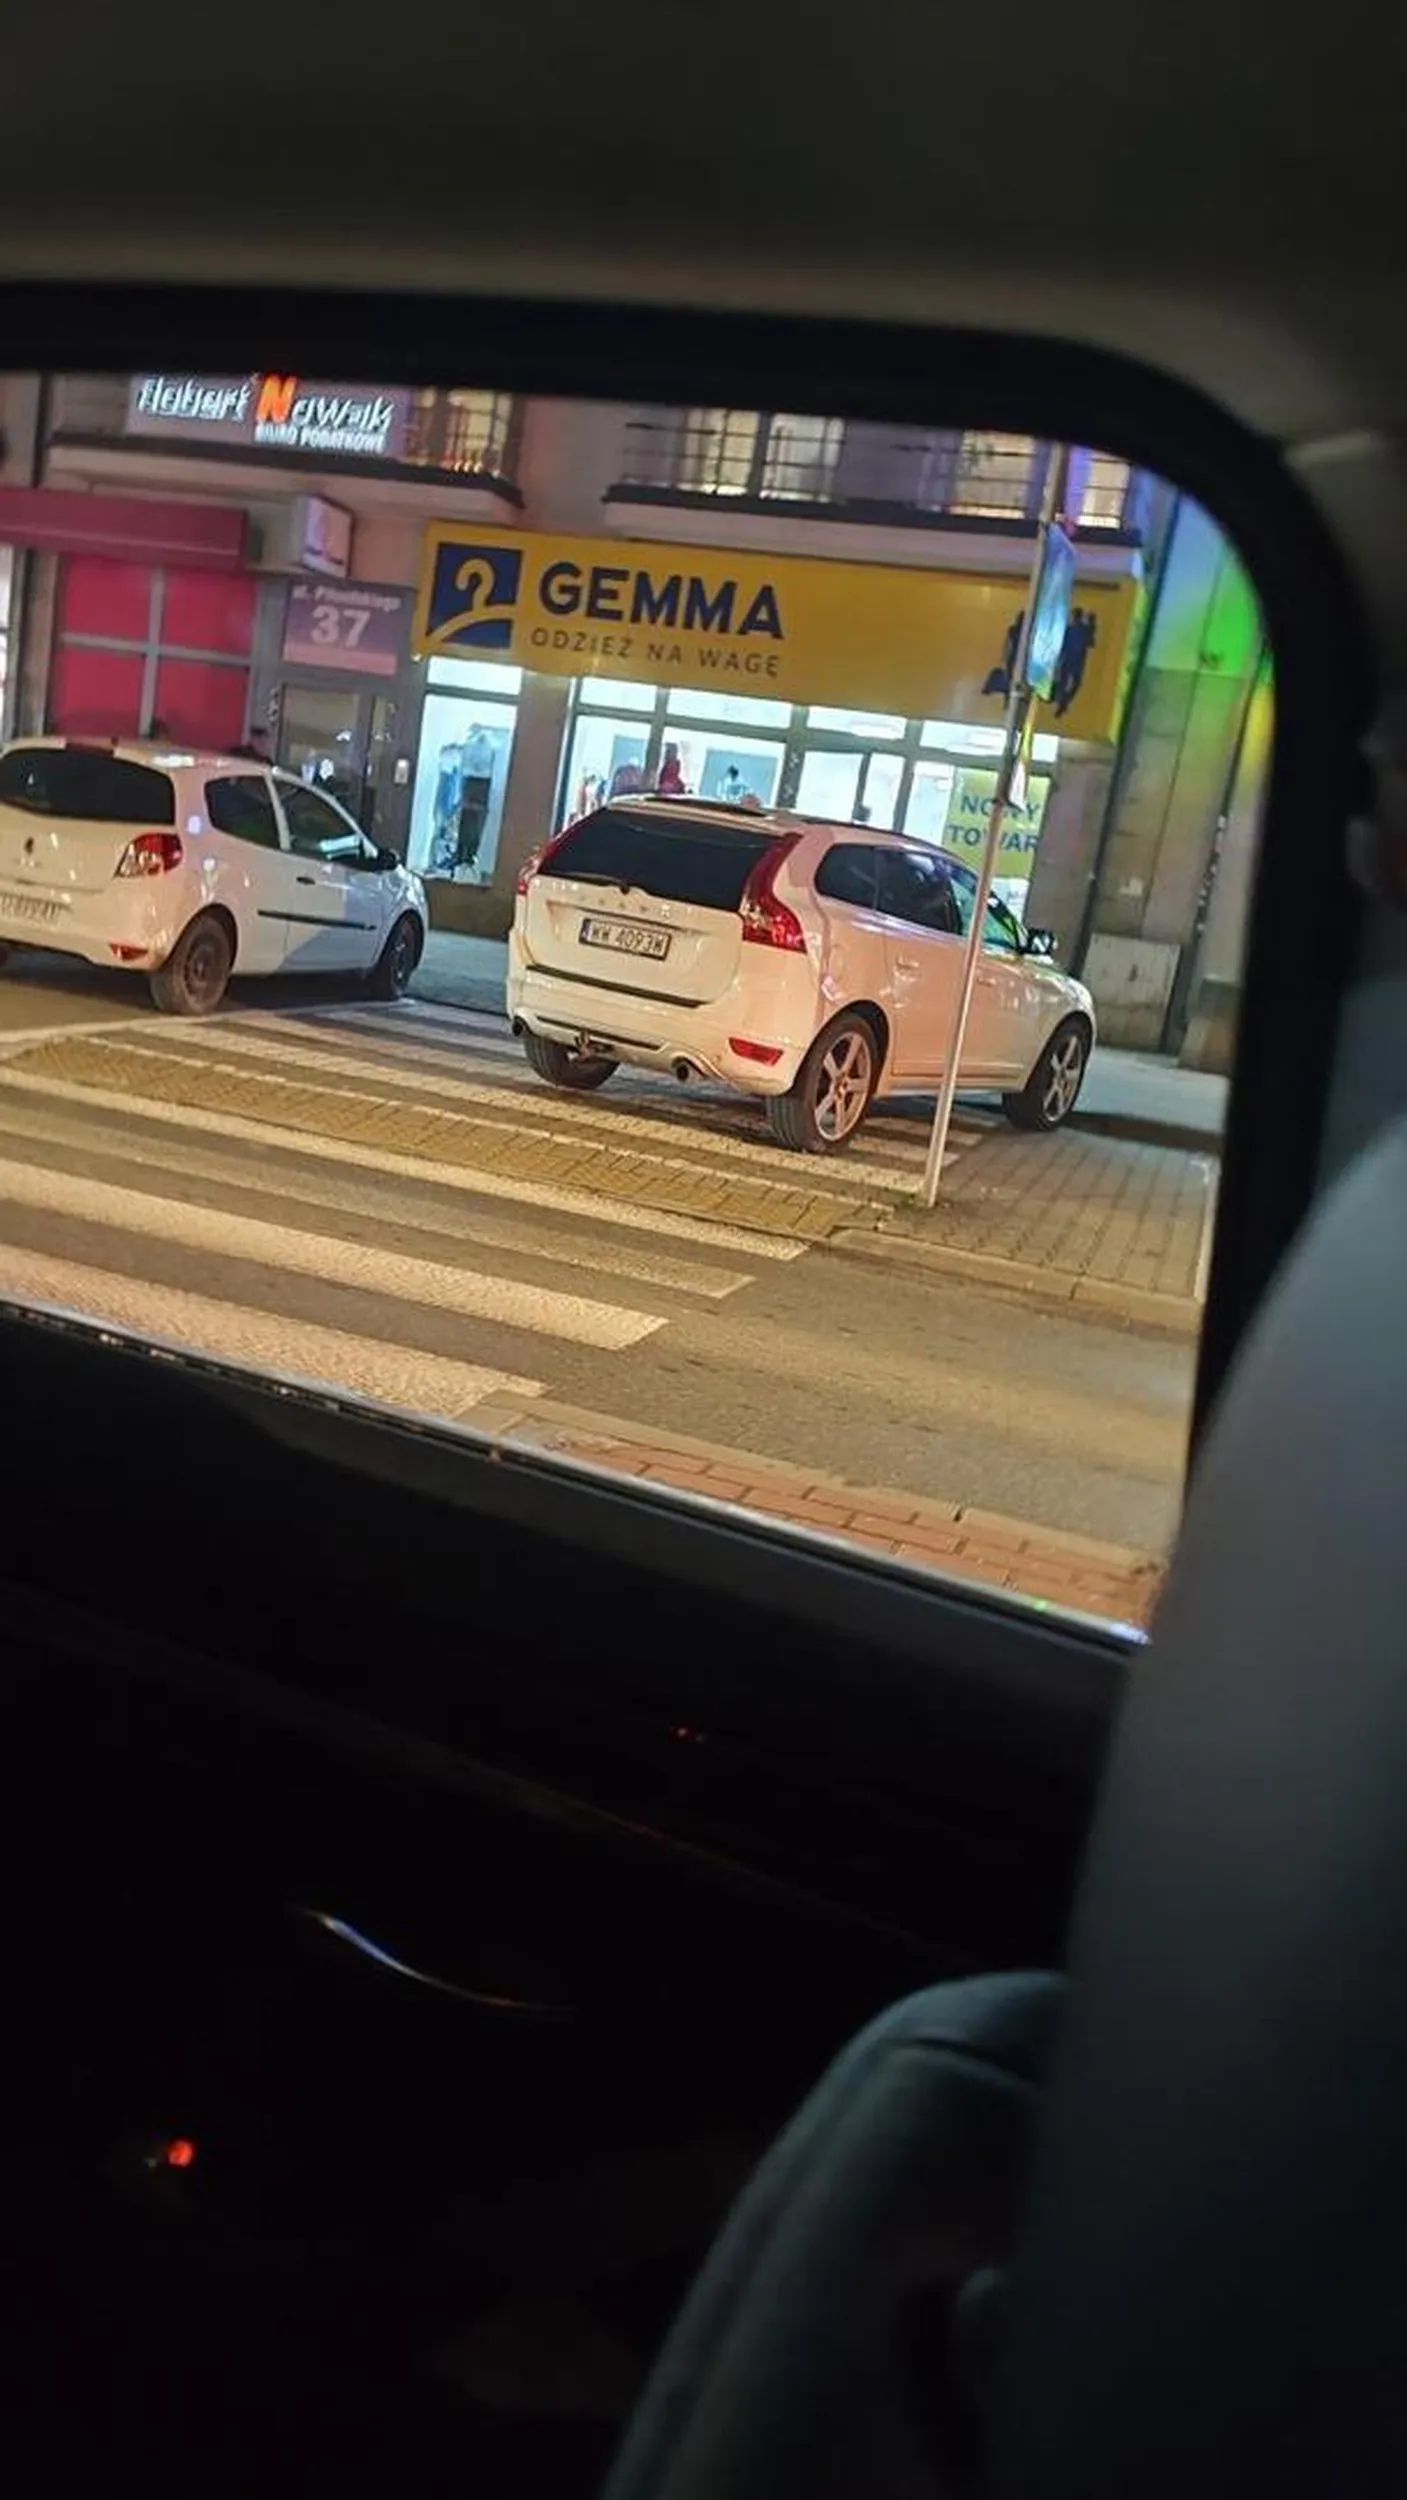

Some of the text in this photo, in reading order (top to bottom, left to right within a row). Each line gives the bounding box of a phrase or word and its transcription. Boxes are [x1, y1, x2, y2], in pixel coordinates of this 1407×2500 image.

[539, 561, 785, 639] GEMMA
[311, 605, 371, 649] 37
[646, 642, 683, 664] NA
